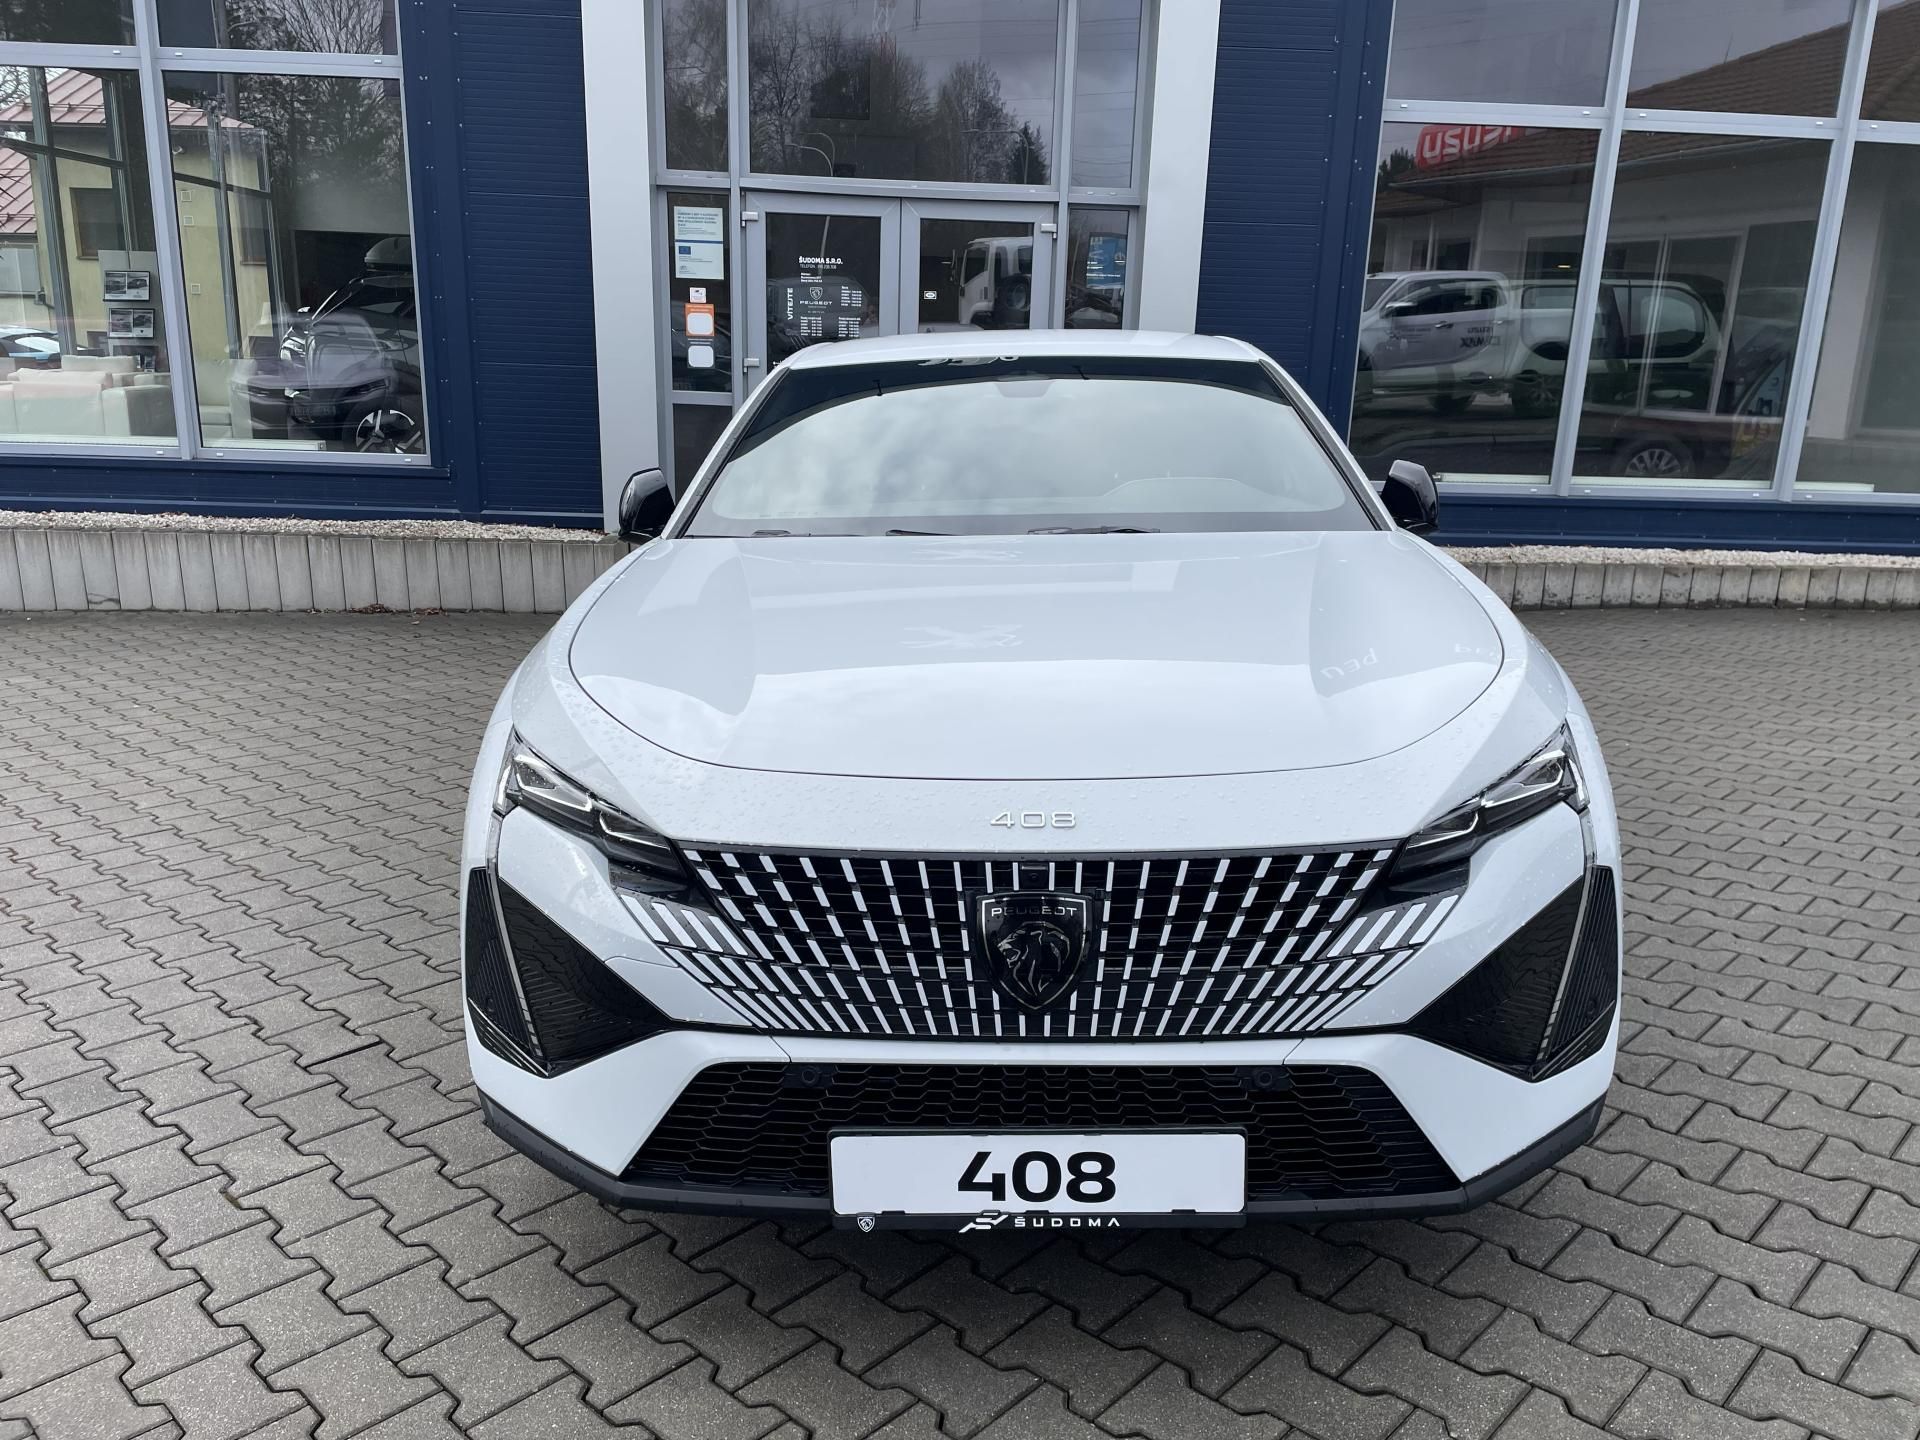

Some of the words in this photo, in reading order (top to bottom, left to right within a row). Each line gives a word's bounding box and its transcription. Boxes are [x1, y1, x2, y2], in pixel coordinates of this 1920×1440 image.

[799, 256, 825, 264] ŠUDOMA
[990, 811, 1077, 829] 408
[991, 906, 1078, 917] PEUGEOT
[957, 1151, 1117, 1203] 408
[1014, 1216, 1121, 1228] ŠUDOMA
